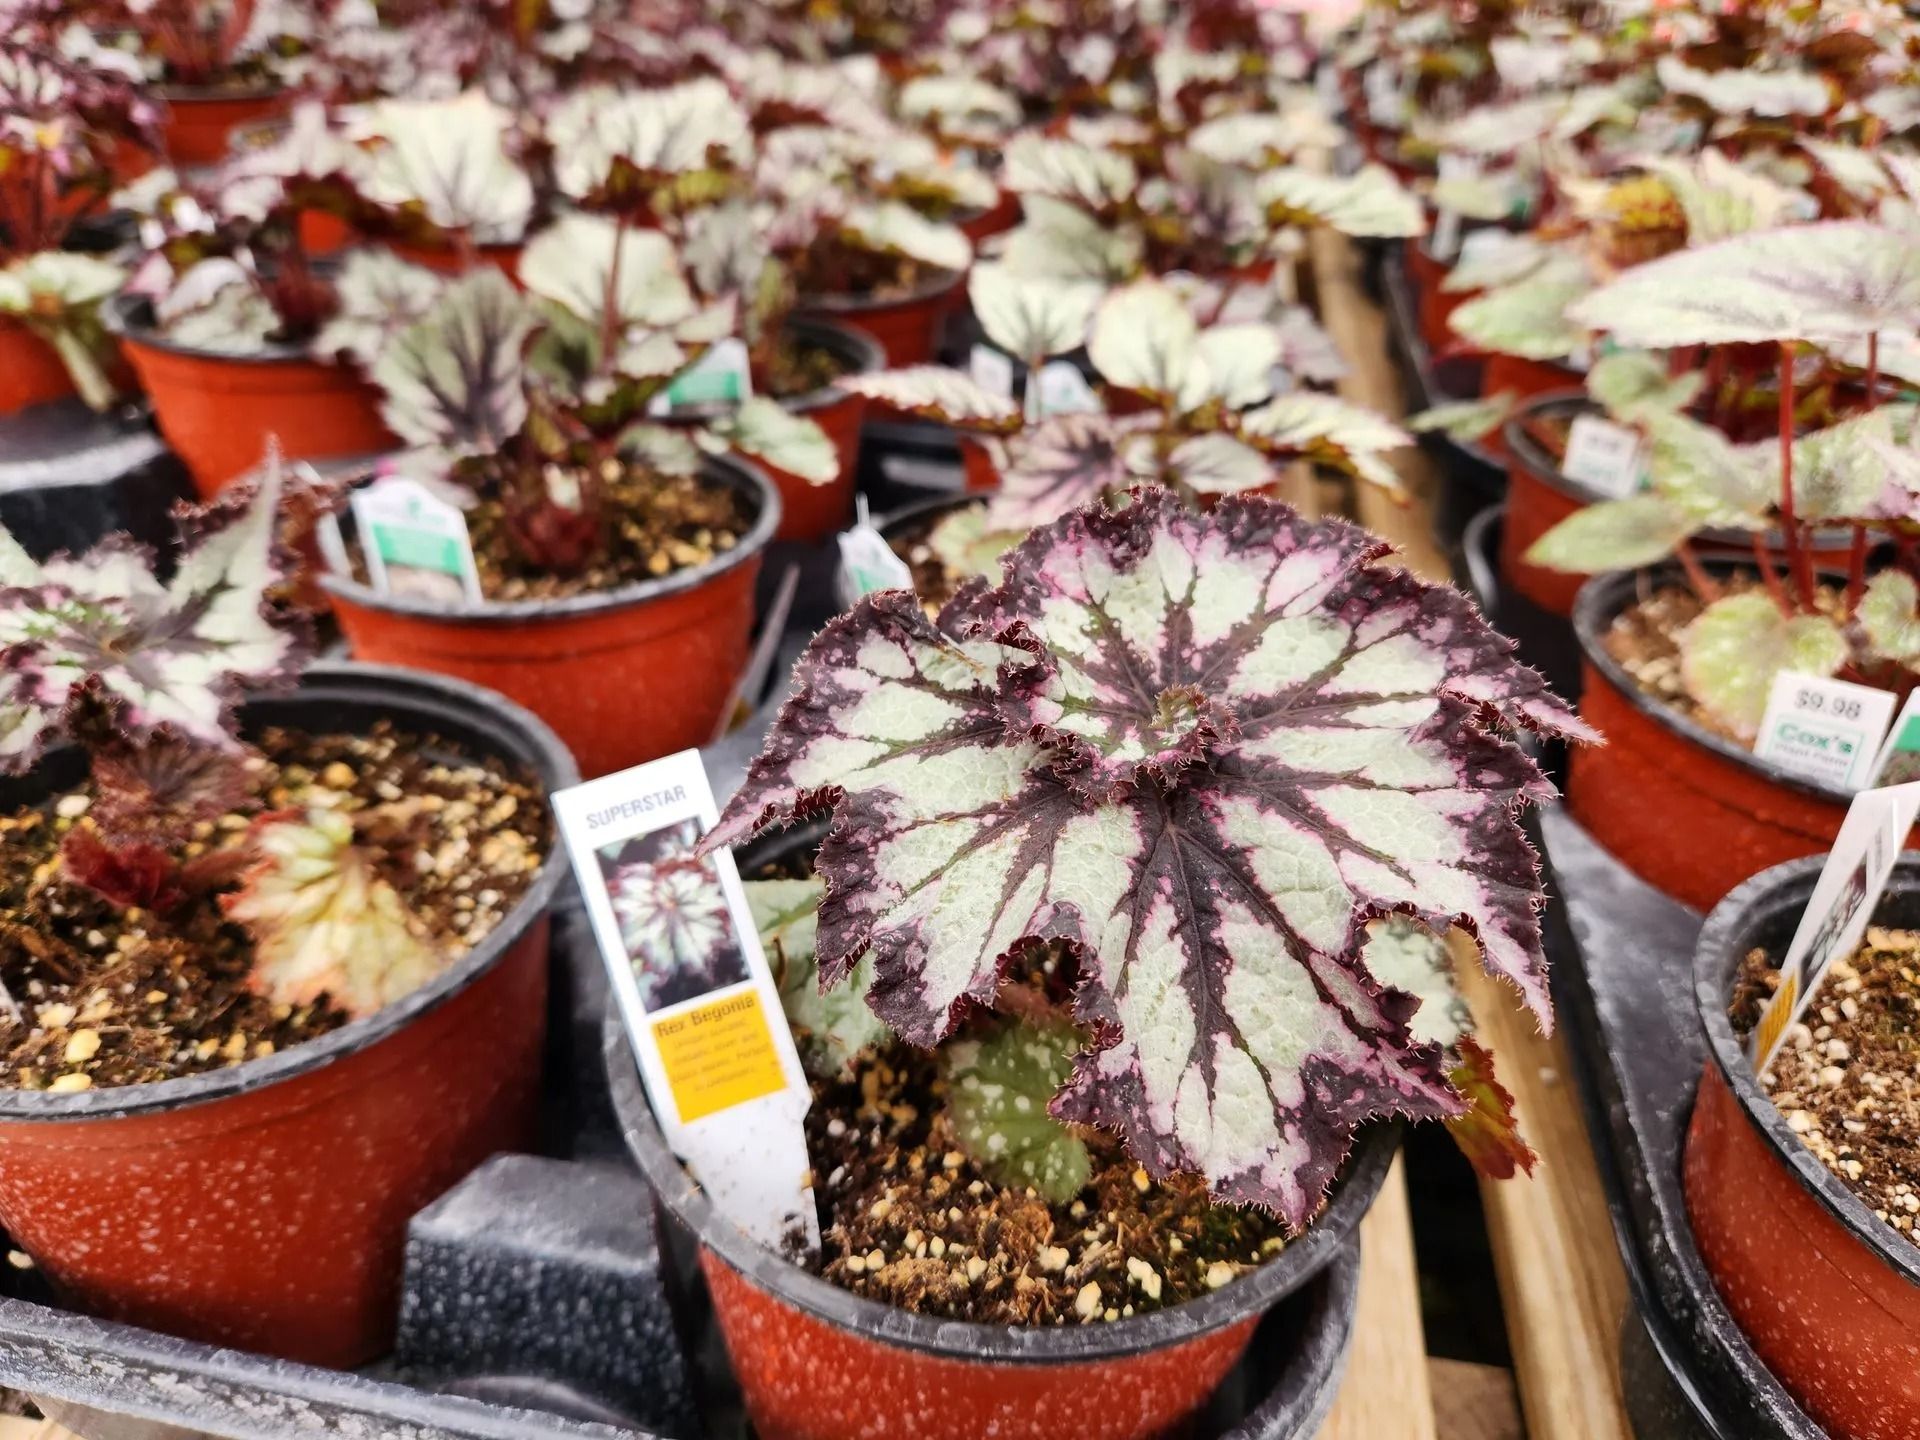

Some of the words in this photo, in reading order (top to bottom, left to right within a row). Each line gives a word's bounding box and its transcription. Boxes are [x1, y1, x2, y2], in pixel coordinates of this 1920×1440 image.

[1797, 690, 1861, 720] $9.98
[1779, 724, 1853, 754] Cox's
[586, 785, 687, 829] SUPERSTAR
[656, 1021, 685, 1037] Rex
[691, 997, 755, 1026] Begonia
